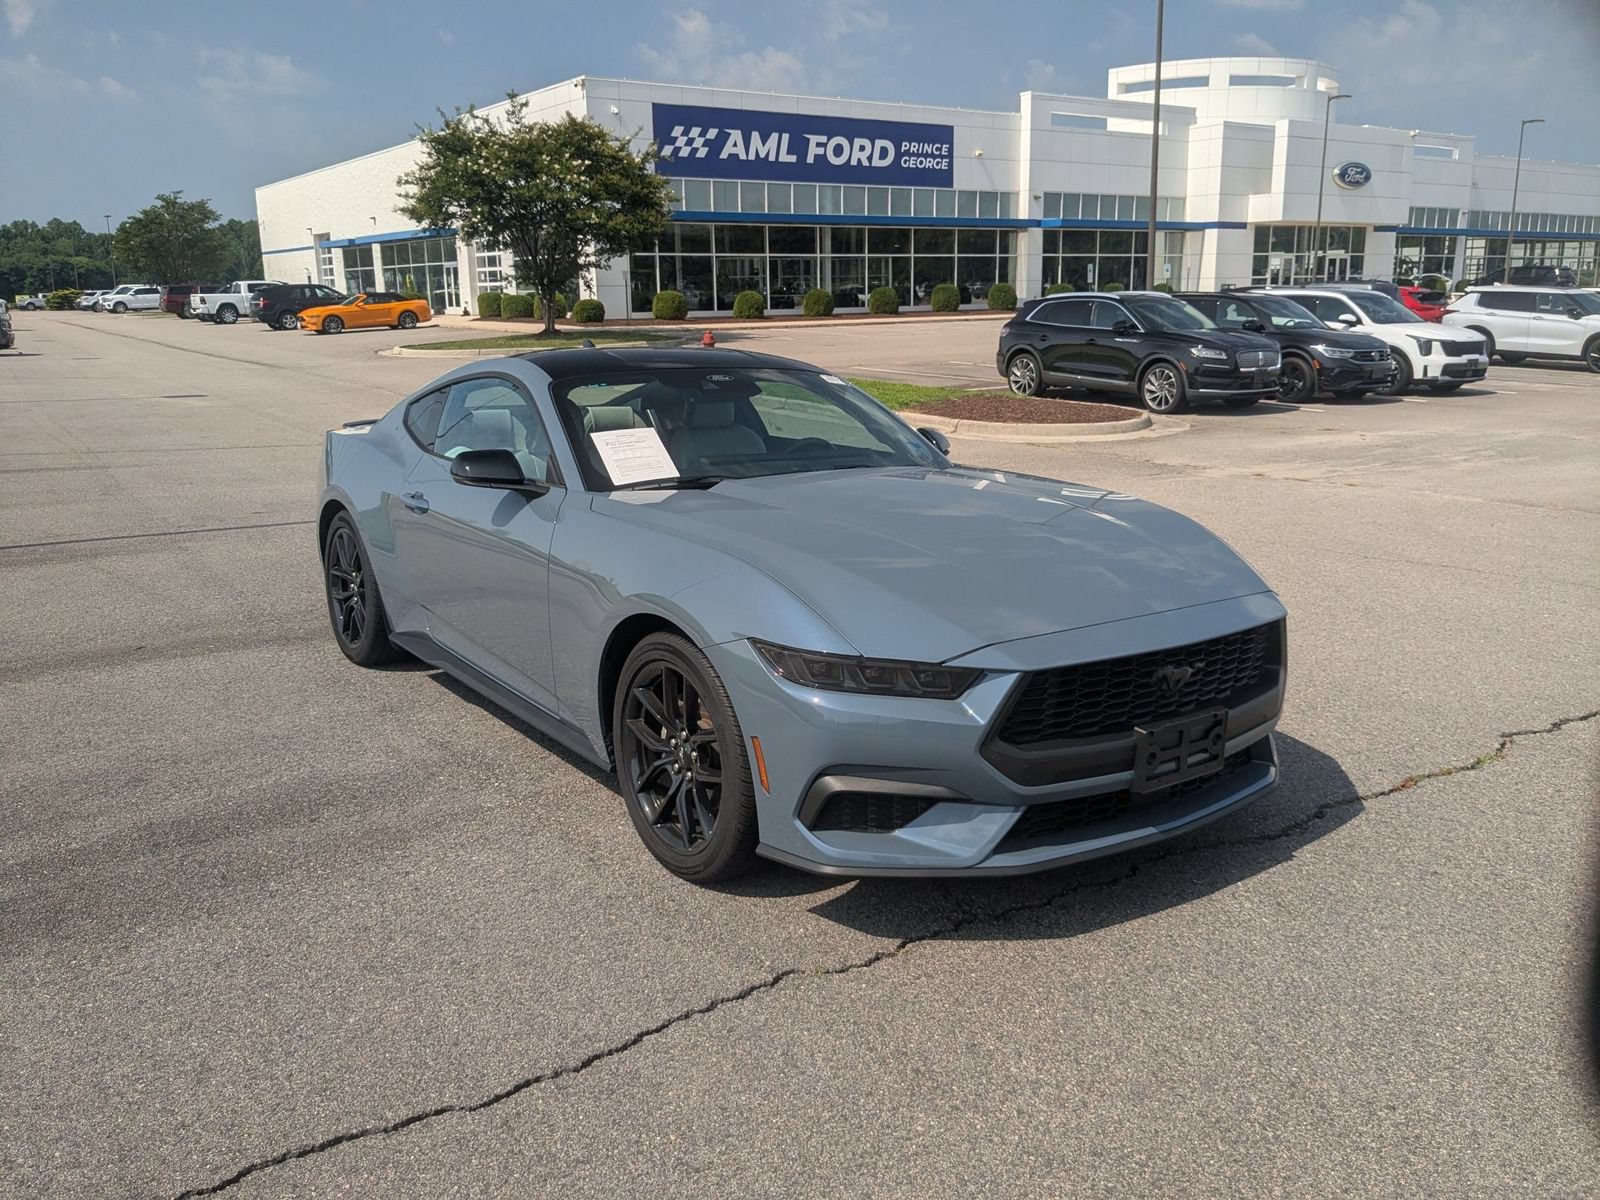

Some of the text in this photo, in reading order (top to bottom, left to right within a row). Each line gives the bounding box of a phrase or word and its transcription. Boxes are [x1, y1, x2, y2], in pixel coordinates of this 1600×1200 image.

[719, 128, 896, 168] AML FORD
[901, 141, 950, 156] PRINCE
[900, 156, 950, 170] GEORGE
